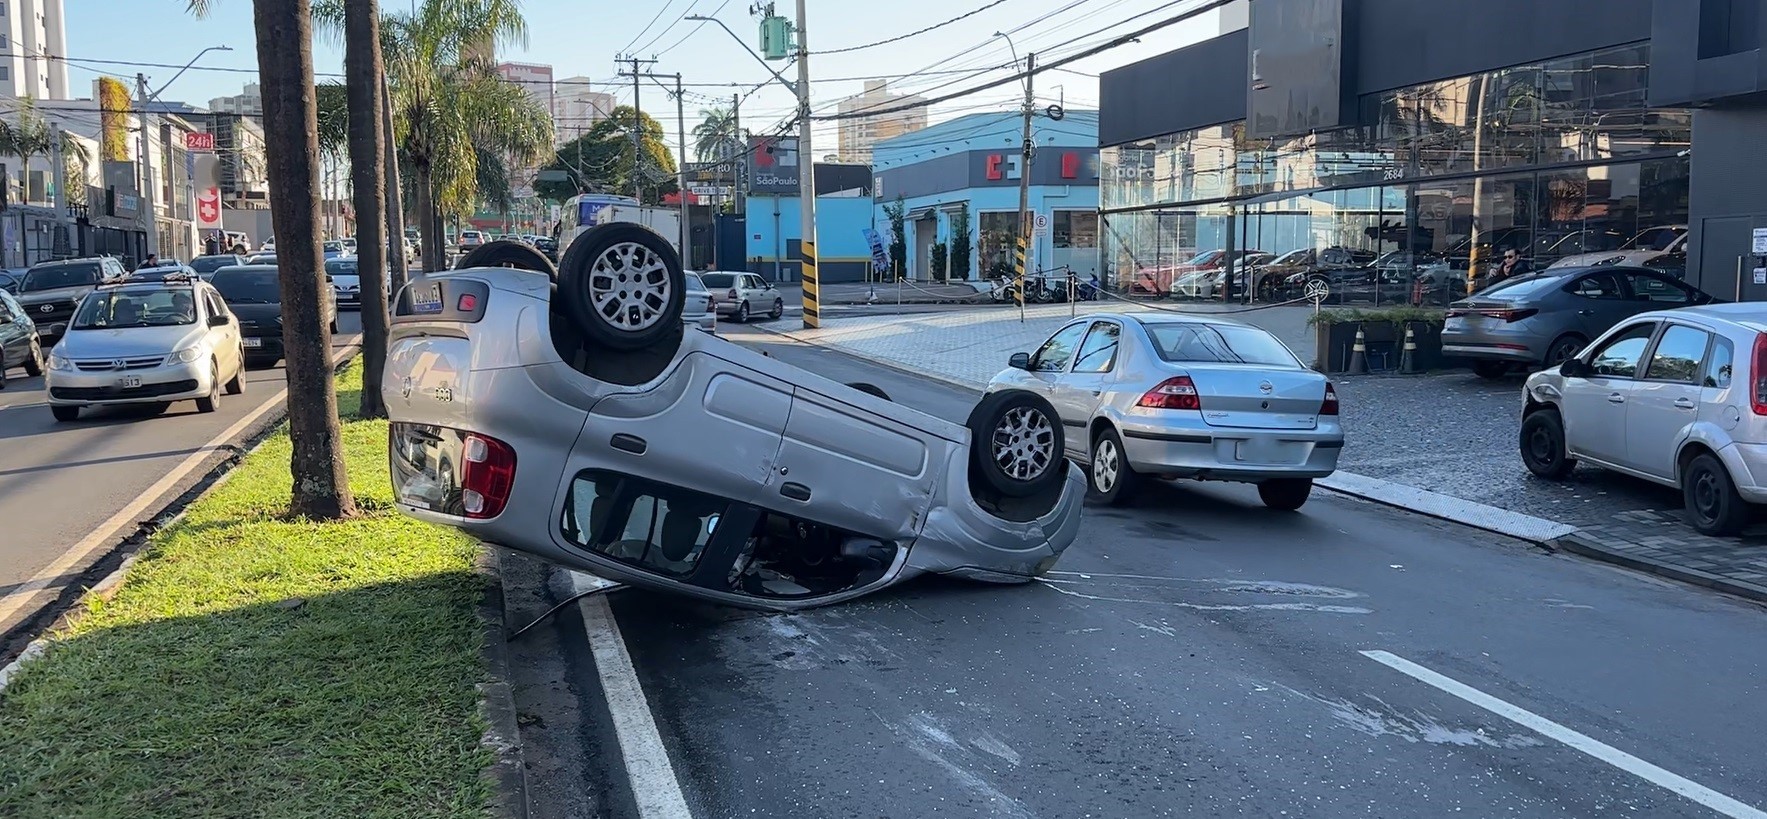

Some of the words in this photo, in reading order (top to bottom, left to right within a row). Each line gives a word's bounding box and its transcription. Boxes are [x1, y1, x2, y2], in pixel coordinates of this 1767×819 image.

[188, 136, 211, 148] 24h
[756, 176, 798, 185] SãoPaulo
[1383, 169, 1403, 181] 2684
